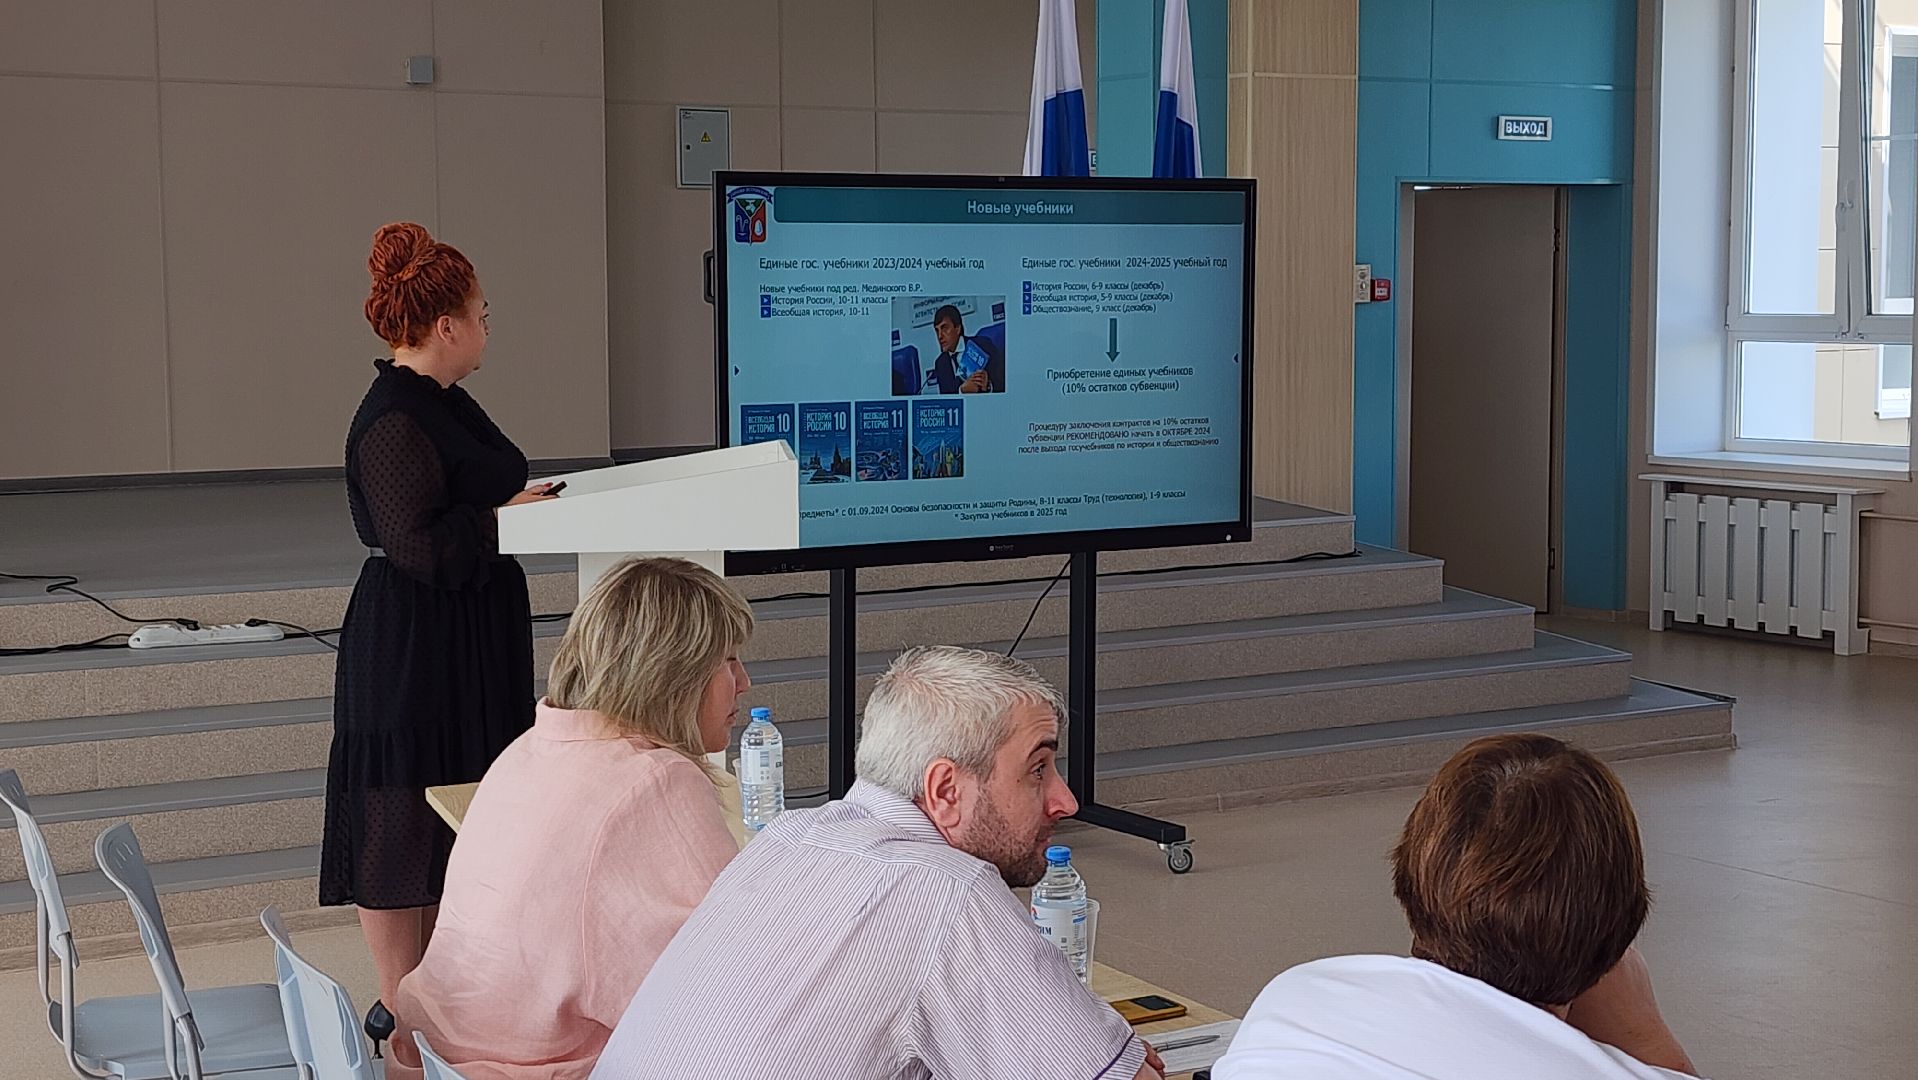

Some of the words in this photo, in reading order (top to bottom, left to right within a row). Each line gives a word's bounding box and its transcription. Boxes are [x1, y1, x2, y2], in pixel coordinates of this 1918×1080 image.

[1505, 121, 1545, 135] ВЫХОД
[967, 200, 1011, 214] Новые
[1014, 201, 1074, 217] учебники
[759, 257, 798, 270] Единые
[801, 259, 820, 269] гос.
[823, 257, 870, 271] учебники
[872, 257, 922, 270] 2023/2024
[925, 257, 966, 271] учебный
[969, 259, 985, 270] год
[1022, 257, 1057, 269] Единые
[1059, 259, 1076, 268] гос.
[1079, 257, 1121, 270] учебники
[1126, 257, 1171, 268] 2024-2025
[1173, 256, 1211, 270] учебный
[1213, 258, 1228, 268] год
[759, 284, 785, 293] Новые
[787, 284, 824, 294] учебники
[826, 285, 841, 294] под
[843, 285, 859, 294] ред.
[861, 284, 906, 294] Мединского
[908, 283, 923, 292] В.Р.
[1033, 282, 1062, 292] История
[1063, 282, 1089, 291] России,
[1091, 281, 1103, 290] 6-9
[1105, 282, 1129, 290] классы
[1130, 281, 1164, 291] (декабрь)
[771, 295, 804, 306] История
[806, 296, 836, 305] России,
[838, 296, 859, 304] 10-11
[861, 296, 888, 304] классы
[1033, 293, 1067, 303] Всеобщая
[1068, 293, 1099, 303] история,
[1101, 292, 1113, 301] 5-9
[1114, 293, 1138, 301] классы
[1140, 292, 1173, 302] (декабрь)
[771, 307, 811, 317] Всеобщая
[812, 308, 846, 317] история,
[849, 307, 869, 315] 10-11
[1033, 304, 1094, 314] Обществознание,
[1095, 304, 1100, 313] 9
[1101, 305, 1121, 313] класс
[1122, 303, 1156, 313] (декабрь)
[1046, 368, 1111, 381] Приобретение
[1113, 367, 1146, 378] единых
[1148, 366, 1194, 378] учебников
[1062, 382, 1086, 395] (10%
[1088, 382, 1127, 392] остатков
[1129, 380, 1180, 393] субвенции)
[776, 412, 791, 433] 10
[806, 412, 832, 422] ИСТОРИЯ
[833, 411, 847, 431] 10
[891, 409, 903, 428] 11
[920, 408, 945, 417] ИСТОРИЯ
[946, 407, 959, 426] 11
[920, 417, 945, 427] РОССИИ
[748, 423, 775, 434] ИСТОРИЯ
[806, 421, 832, 432] РОССИИ
[863, 420, 889, 429] ИСТОРИЯ
[1028, 422, 1067, 432] Процедуру
[1069, 421, 1111, 429] заключения
[1112, 420, 1151, 429] контрактов
[1163, 417, 1179, 426] 10%
[1179, 417, 1209, 425] остатков
[1027, 434, 1065, 444] субвенции
[1066, 430, 1130, 440] РЕКОМЕНДОВАНО
[1131, 430, 1155, 438] начать
[1161, 427, 1193, 436] ОКТЯБРЕ
[1194, 426, 1211, 435] 2024
[1040, 444, 1067, 453] выхода
[1068, 442, 1115, 452] госучебников
[1126, 440, 1155, 449] истории
[1162, 438, 1219, 447] обществознанию
[841, 508, 847, 516] с
[847, 505, 889, 516] 01.09.2024
[890, 504, 919, 513] Основы
[921, 502, 971, 512] безопасности
[979, 500, 1007, 509] защиты
[1008, 498, 1038, 507] Родины,
[1039, 496, 1055, 505] 8-11
[1057, 496, 1081, 504] классы
[1083, 494, 1100, 504] Труд
[1101, 492, 1148, 503] (технология),
[1150, 490, 1161, 499] 1-9
[1162, 490, 1186, 498] классы
[960, 512, 990, 522] Закупка
[991, 510, 1029, 521] учебников
[1036, 507, 1054, 516] 2025
[1055, 508, 1068, 516] год
